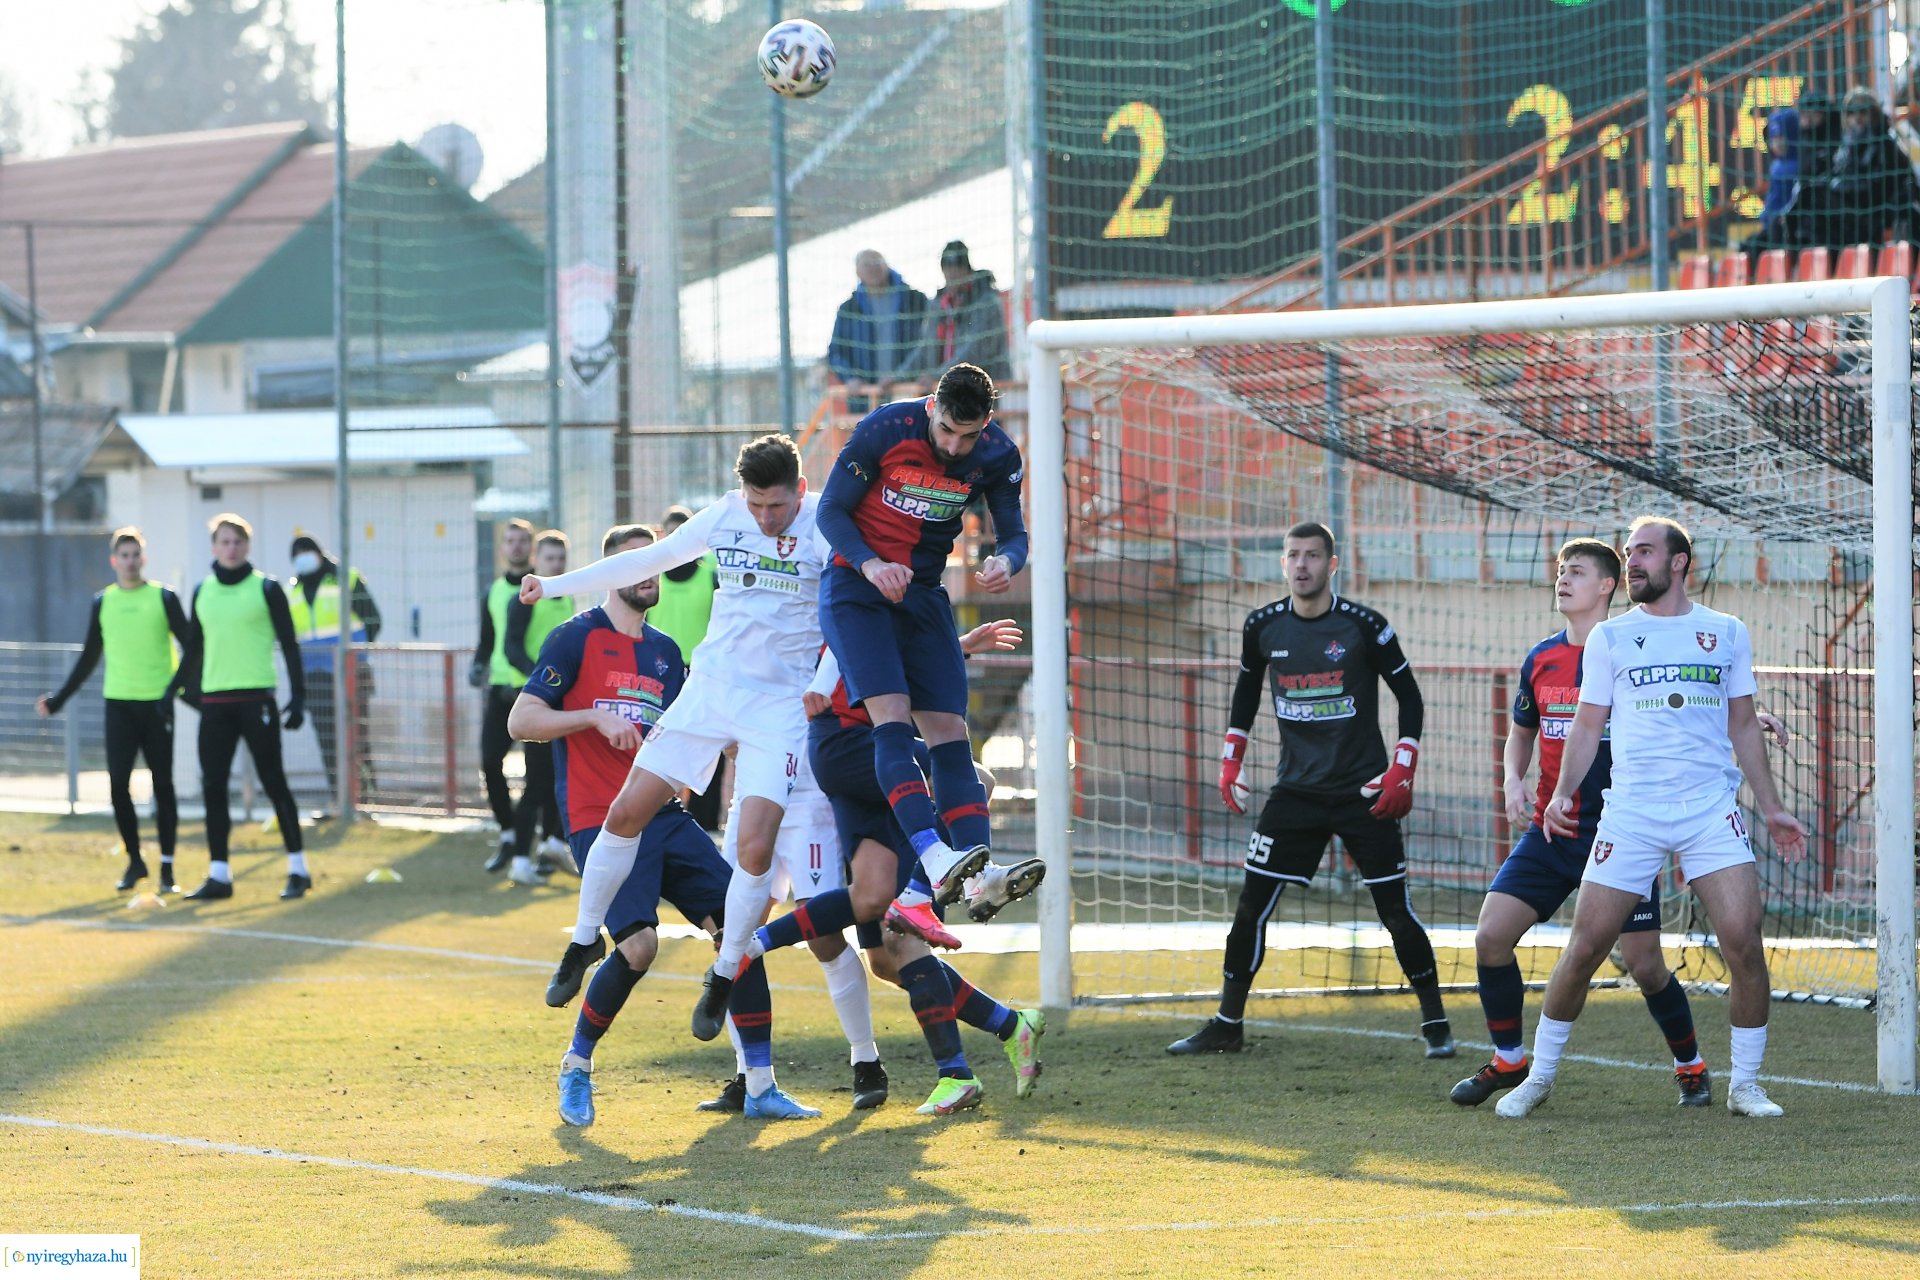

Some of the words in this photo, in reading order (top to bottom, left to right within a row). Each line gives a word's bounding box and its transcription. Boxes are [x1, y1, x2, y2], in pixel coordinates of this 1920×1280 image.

[1102, 101, 1174, 238] 2
[809, 843, 821, 869] 11
[1247, 831, 1275, 864] 95
[1633, 912, 1653, 921] JAKO
